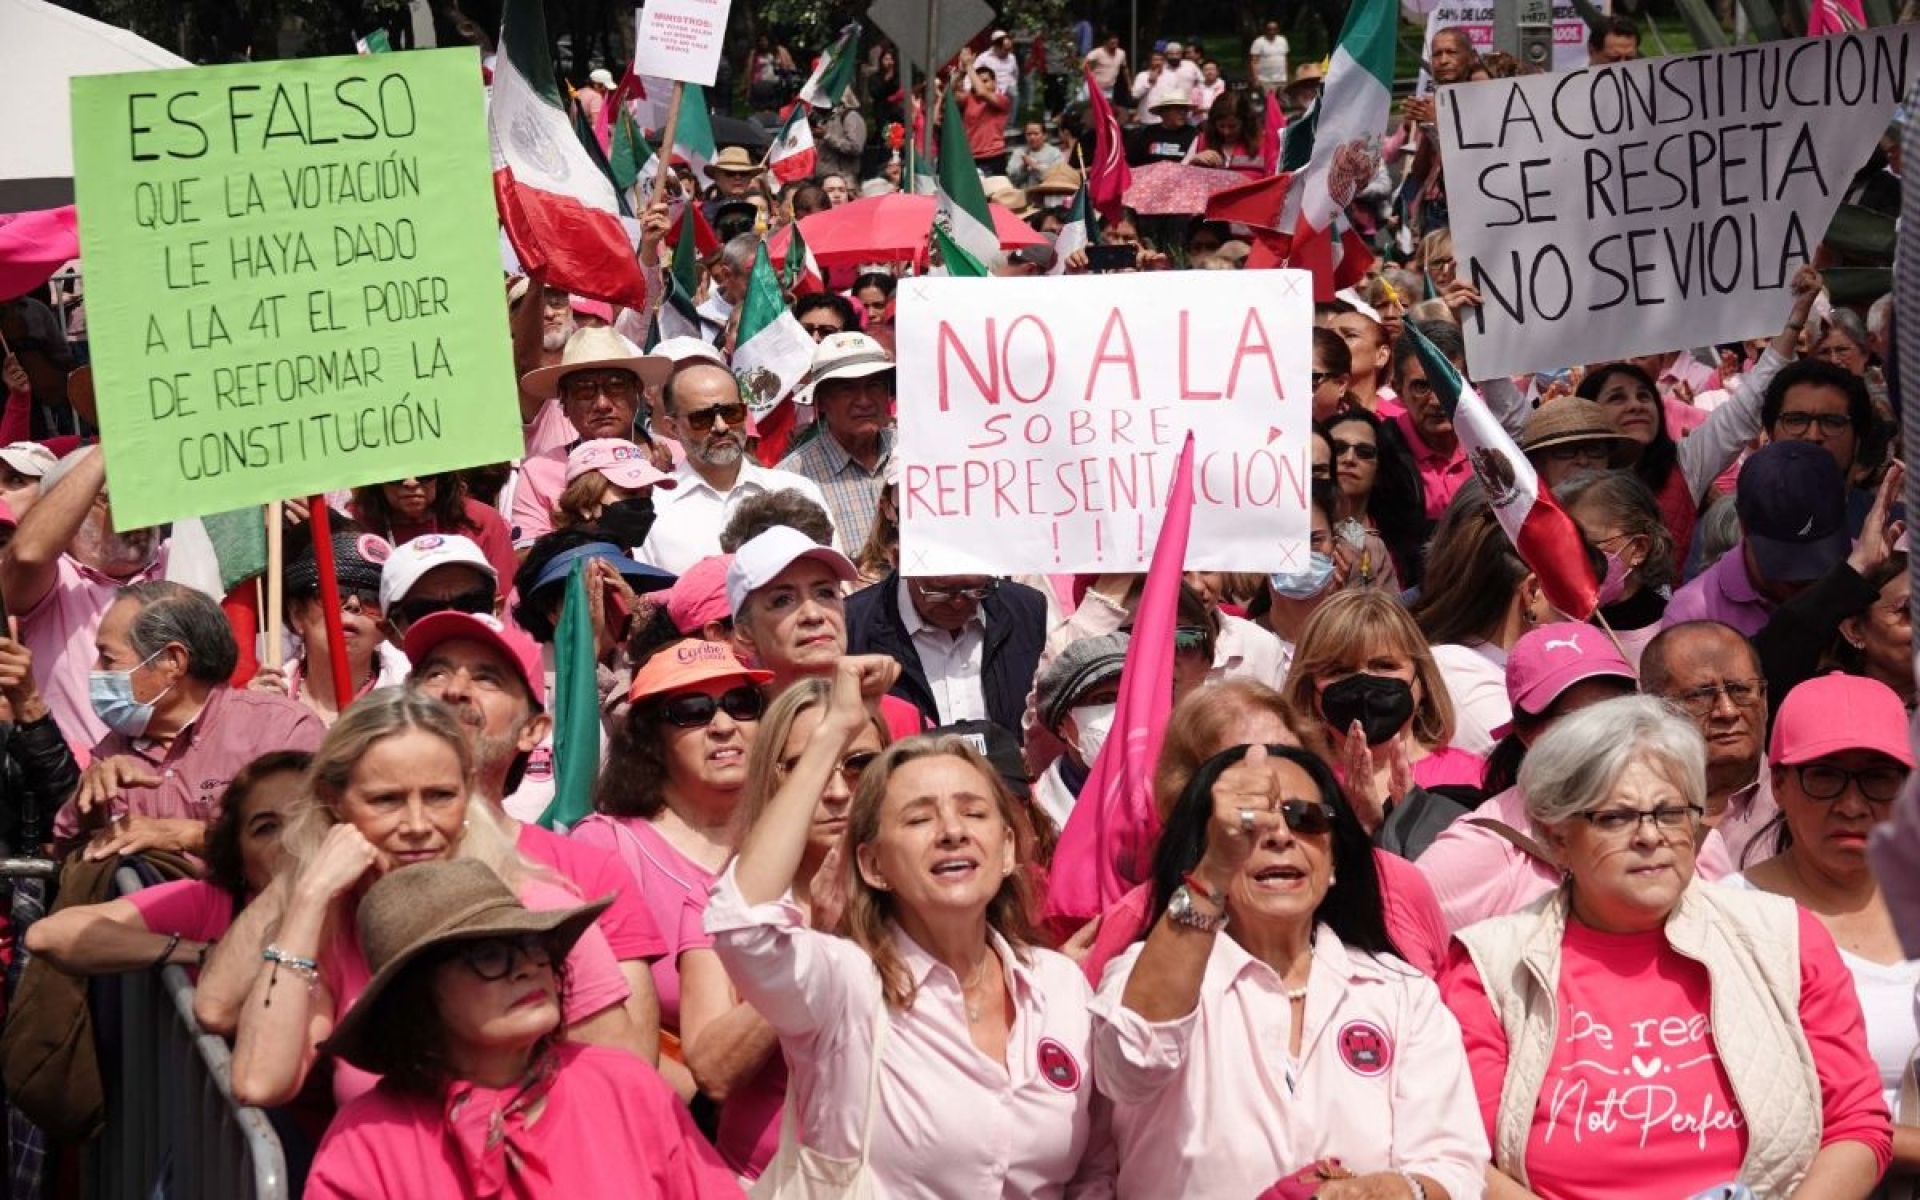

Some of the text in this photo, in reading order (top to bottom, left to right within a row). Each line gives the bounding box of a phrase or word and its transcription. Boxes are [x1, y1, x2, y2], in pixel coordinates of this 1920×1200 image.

[129, 73, 416, 162] ES FALSO
[1449, 33, 1909, 150] LA CONSTITUCION
[135, 150, 420, 230] QUE LA VOTACIÓN
[1478, 122, 1829, 227] SE RESPETA
[165, 218, 417, 289] LE HAYA DADO
[1470, 244, 1574, 334] NO
[145, 276, 450, 356] A LA 4T EL PODER
[937, 307, 1285, 411] NO A LA
[149, 337, 454, 420] DE REFORMAR LA
[179, 392, 442, 481] CONSTITUCIÓN
[968, 406, 1171, 448] SOBRE
